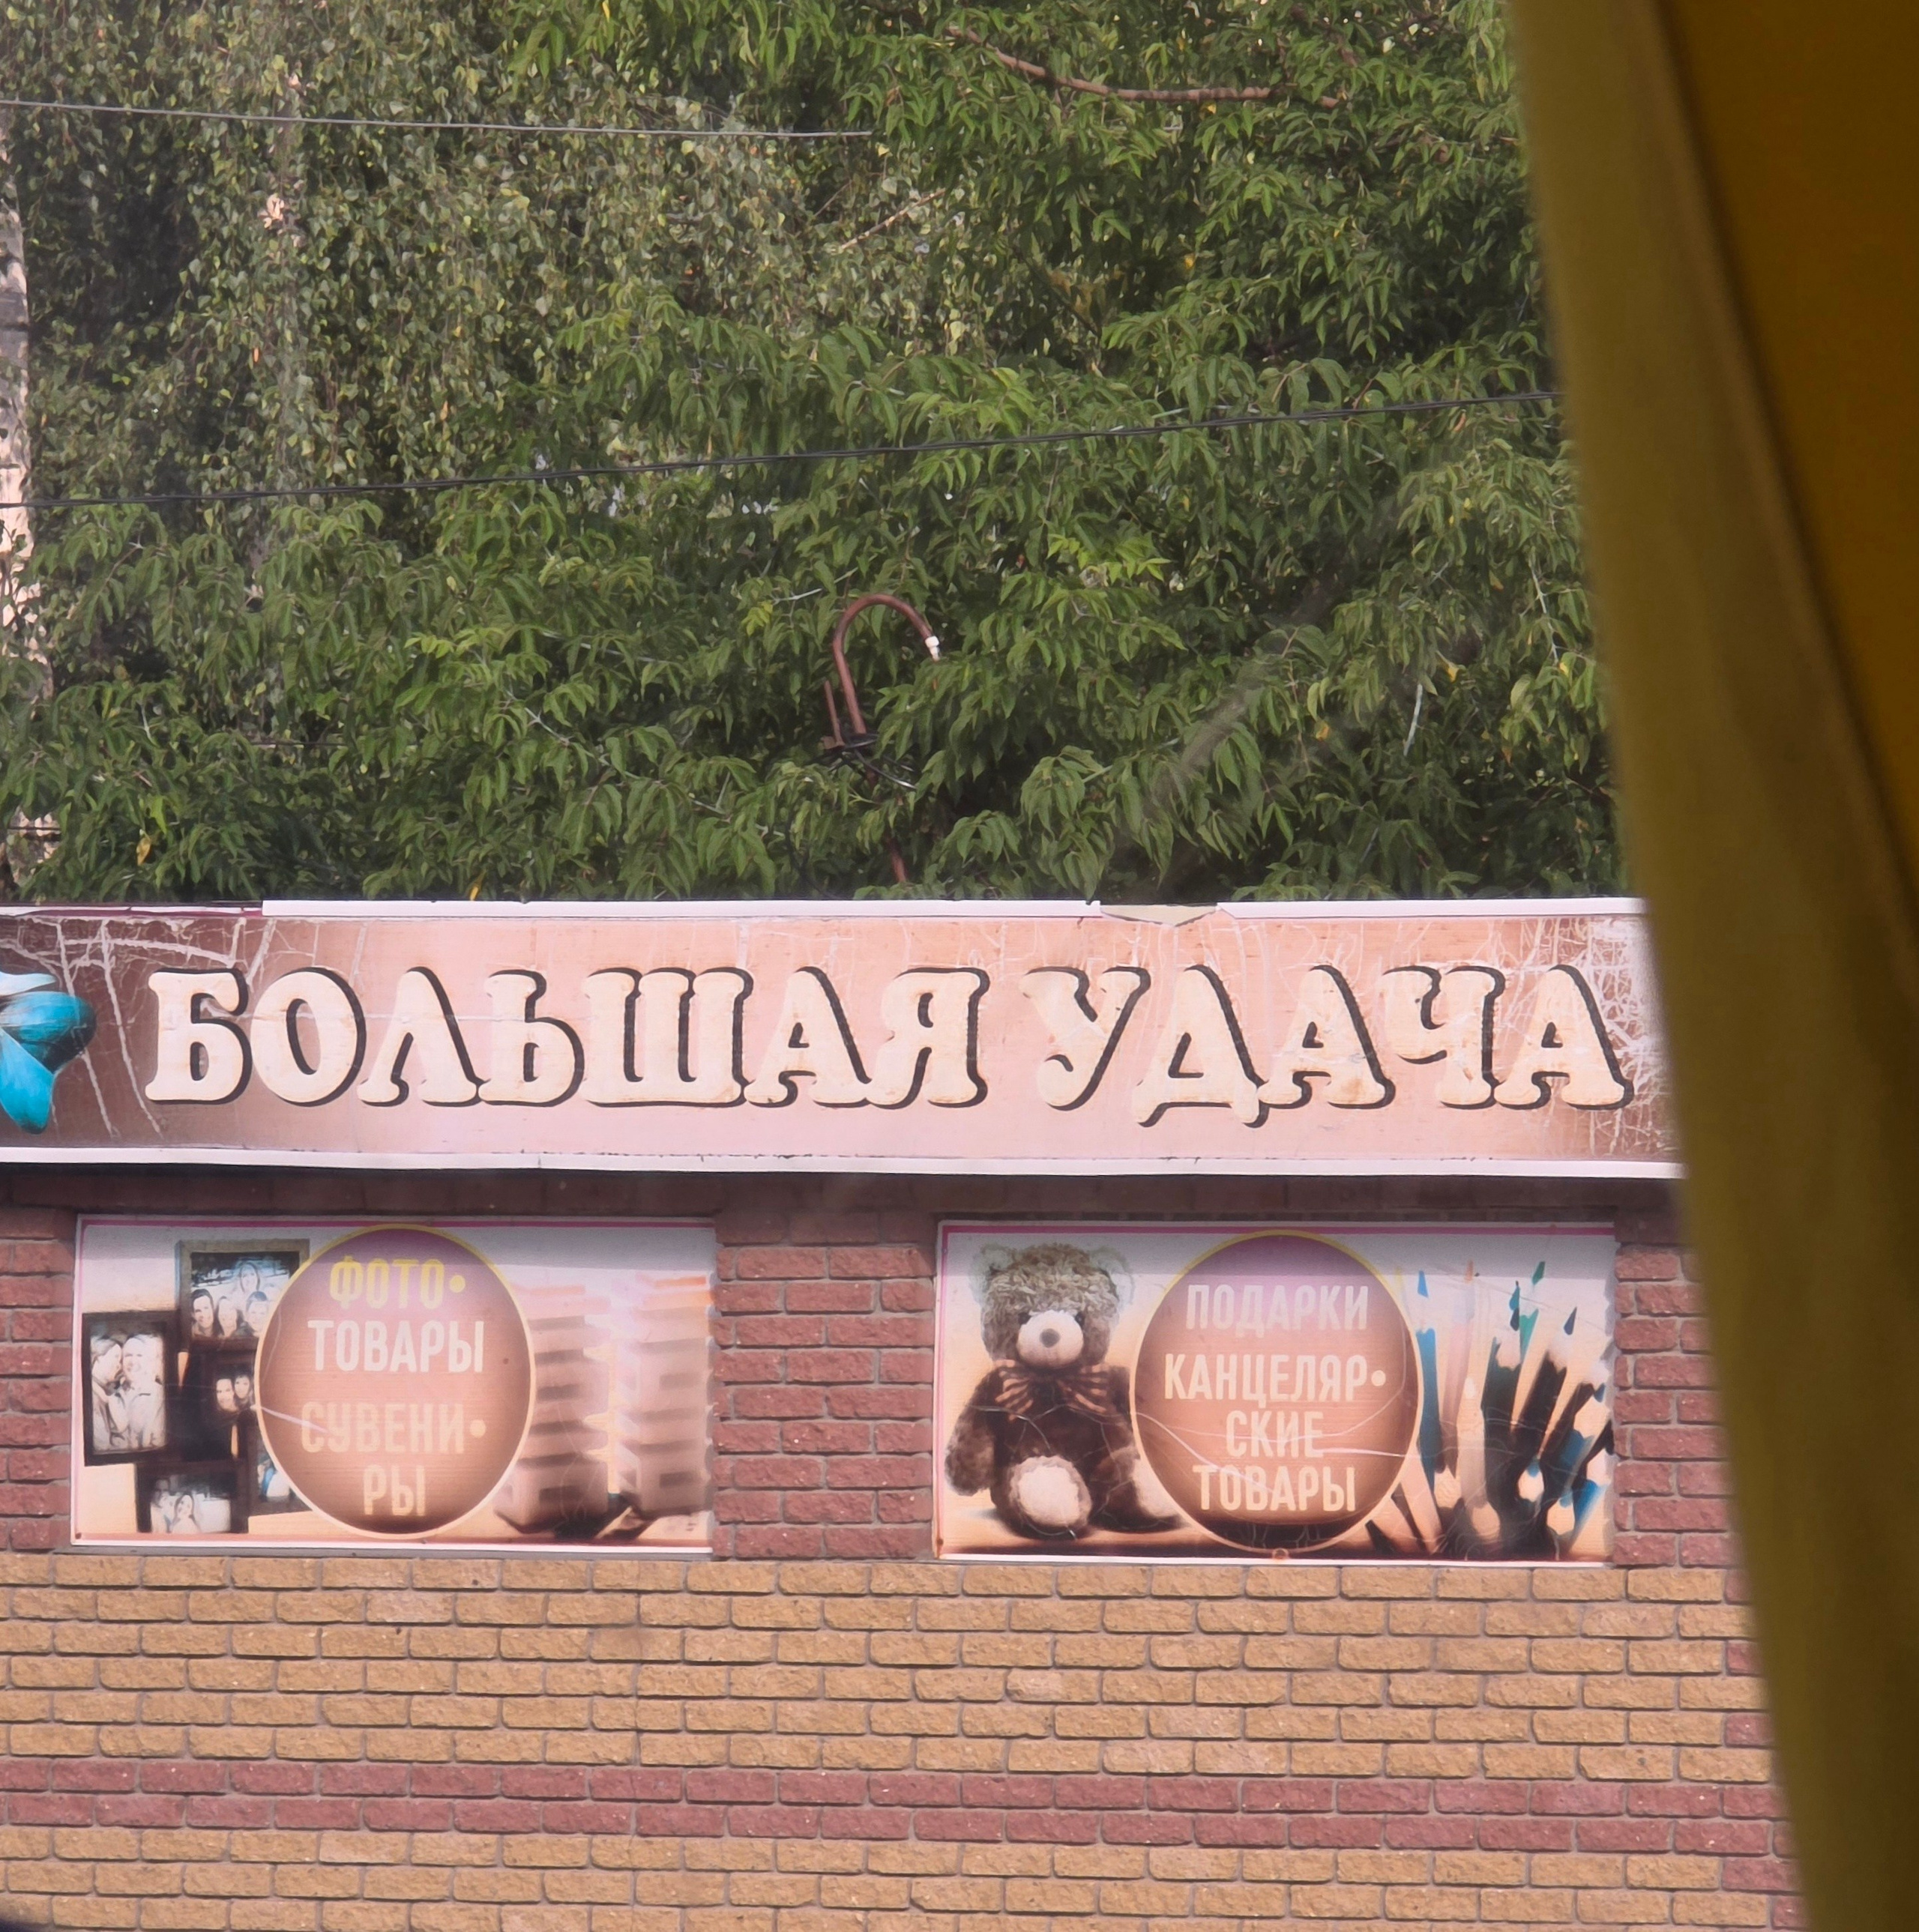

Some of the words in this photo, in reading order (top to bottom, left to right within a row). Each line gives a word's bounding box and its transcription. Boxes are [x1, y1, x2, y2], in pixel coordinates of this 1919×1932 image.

[145, 965, 989, 1109] БОЛЬШАЯ
[1021, 964, 1636, 1127] УДАЧА
[1185, 1284, 1369, 1338] ПОДАРКИ
[307, 1320, 484, 1373] ТОВАРЫ
[1226, 1410, 1325, 1458] СКИЕ
[363, 1464, 427, 1517] РЫ
[1192, 1464, 1357, 1513] ТОВАРЫ
